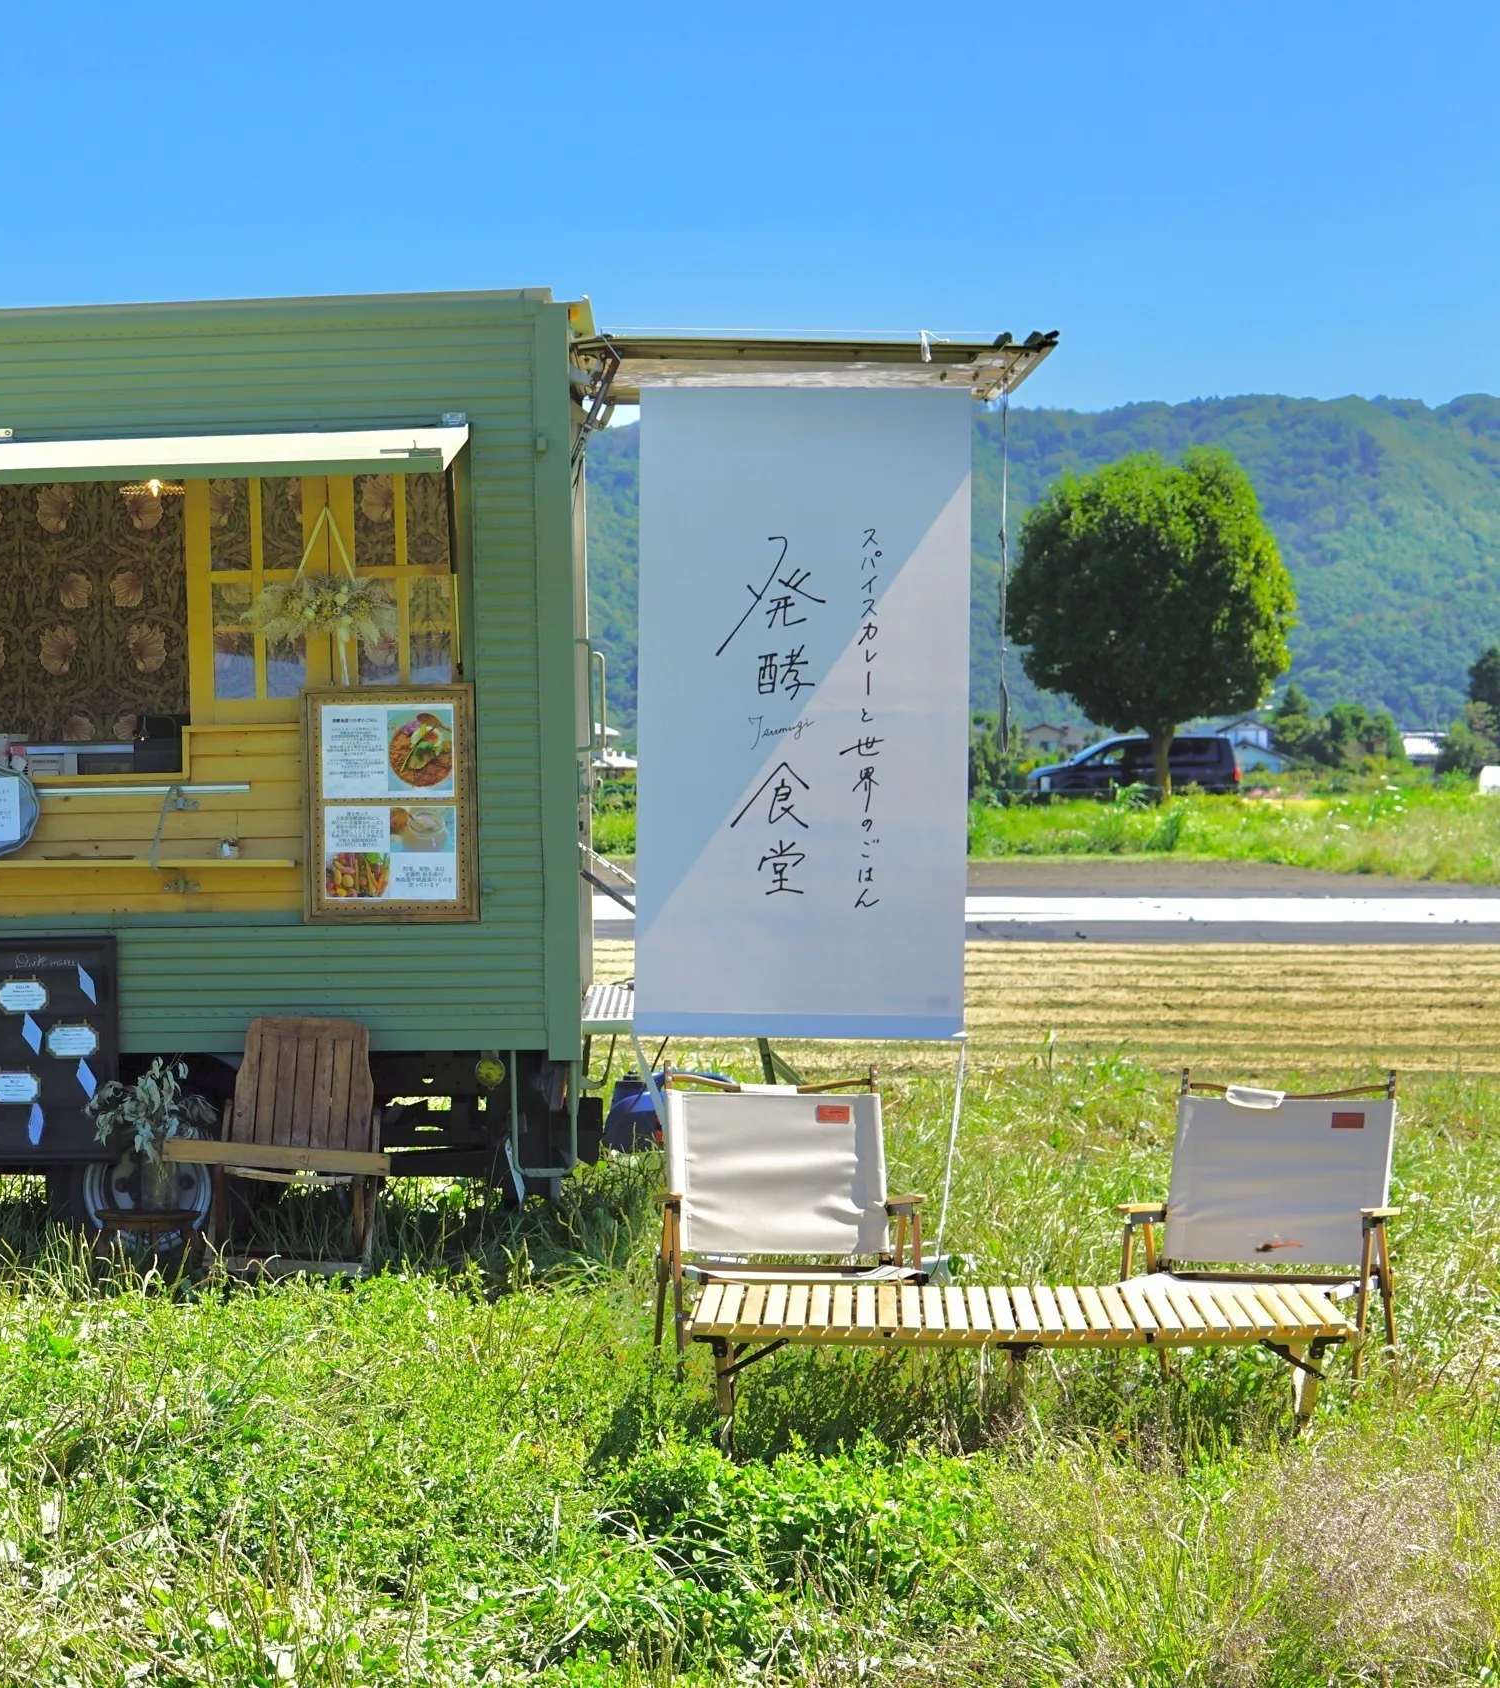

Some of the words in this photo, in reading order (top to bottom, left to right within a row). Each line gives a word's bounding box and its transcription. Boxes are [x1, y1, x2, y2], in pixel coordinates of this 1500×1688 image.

[839, 528, 885, 909] スパイスカレーと世界のごはん
